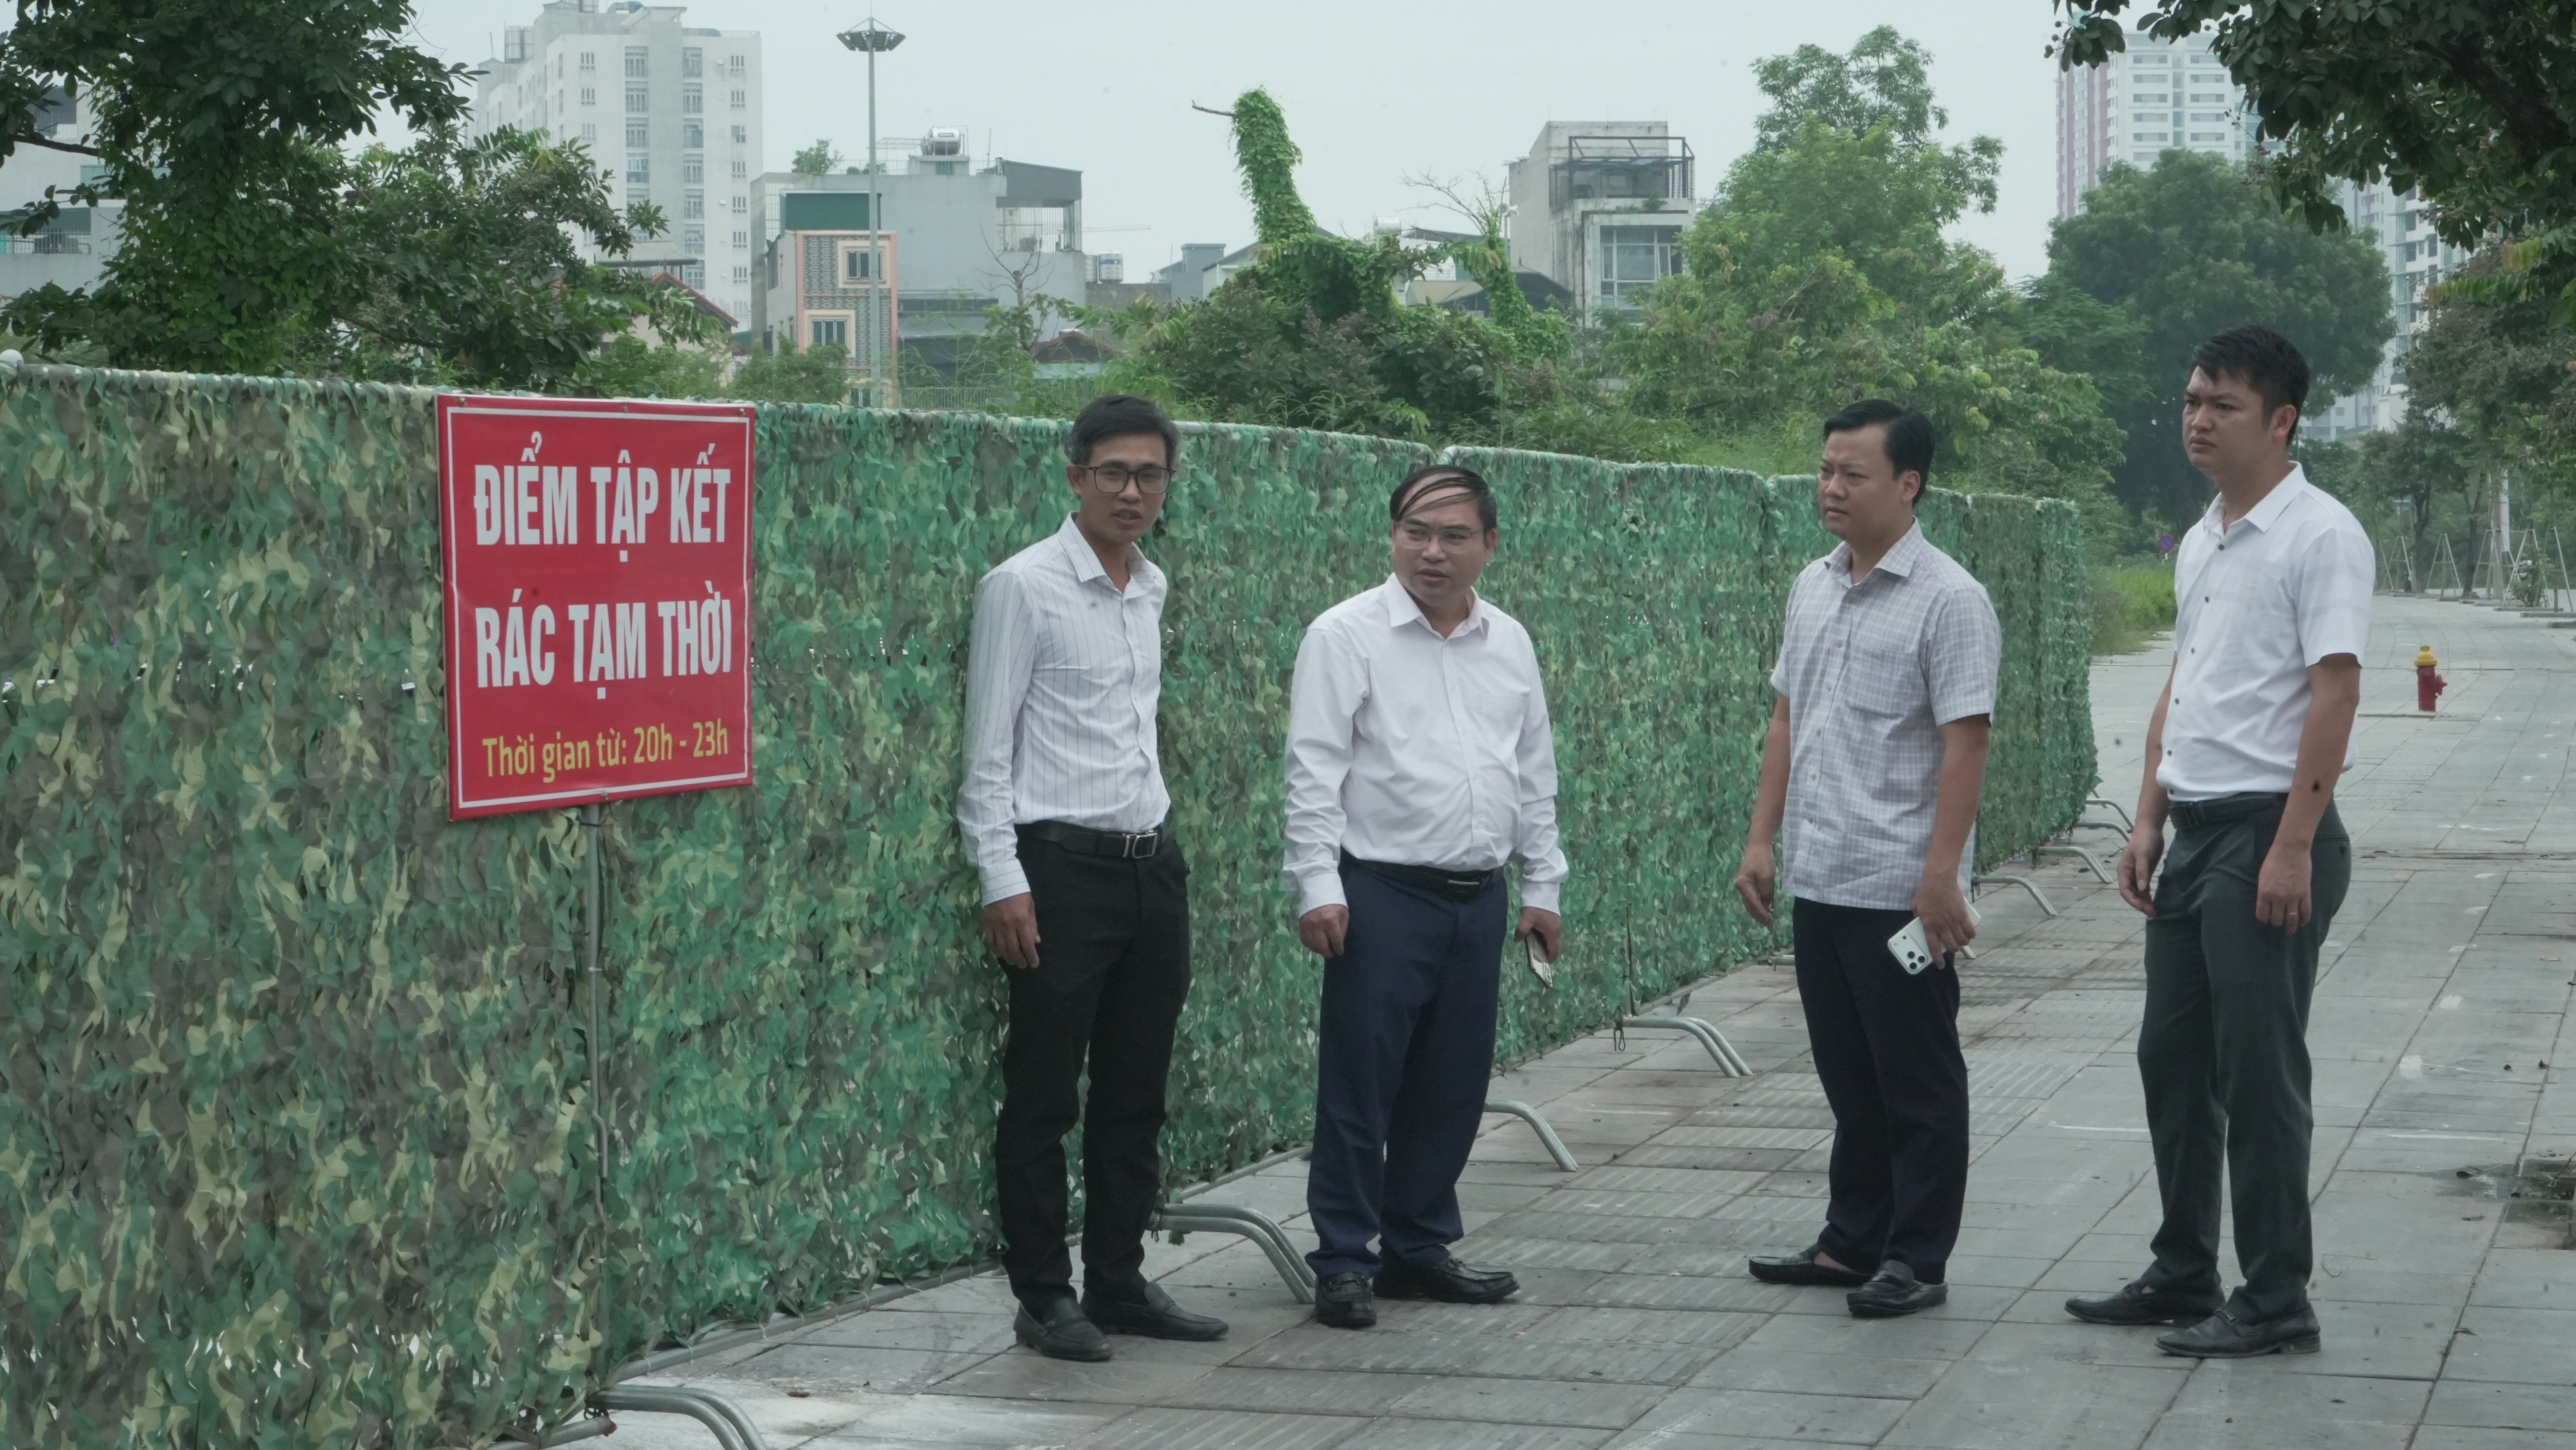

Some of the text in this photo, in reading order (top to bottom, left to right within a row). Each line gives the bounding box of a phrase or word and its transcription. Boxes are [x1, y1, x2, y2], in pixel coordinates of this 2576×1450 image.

[473, 431, 731, 563] ĐIỂM TẬP KẾT
[475, 580, 732, 700] RÁC TẠM THỜI
[482, 733, 535, 777] Thời
[542, 731, 590, 783] gian
[596, 728, 627, 767] từ:
[634, 723, 673, 763] 20h
[693, 718, 728, 757] 23h
